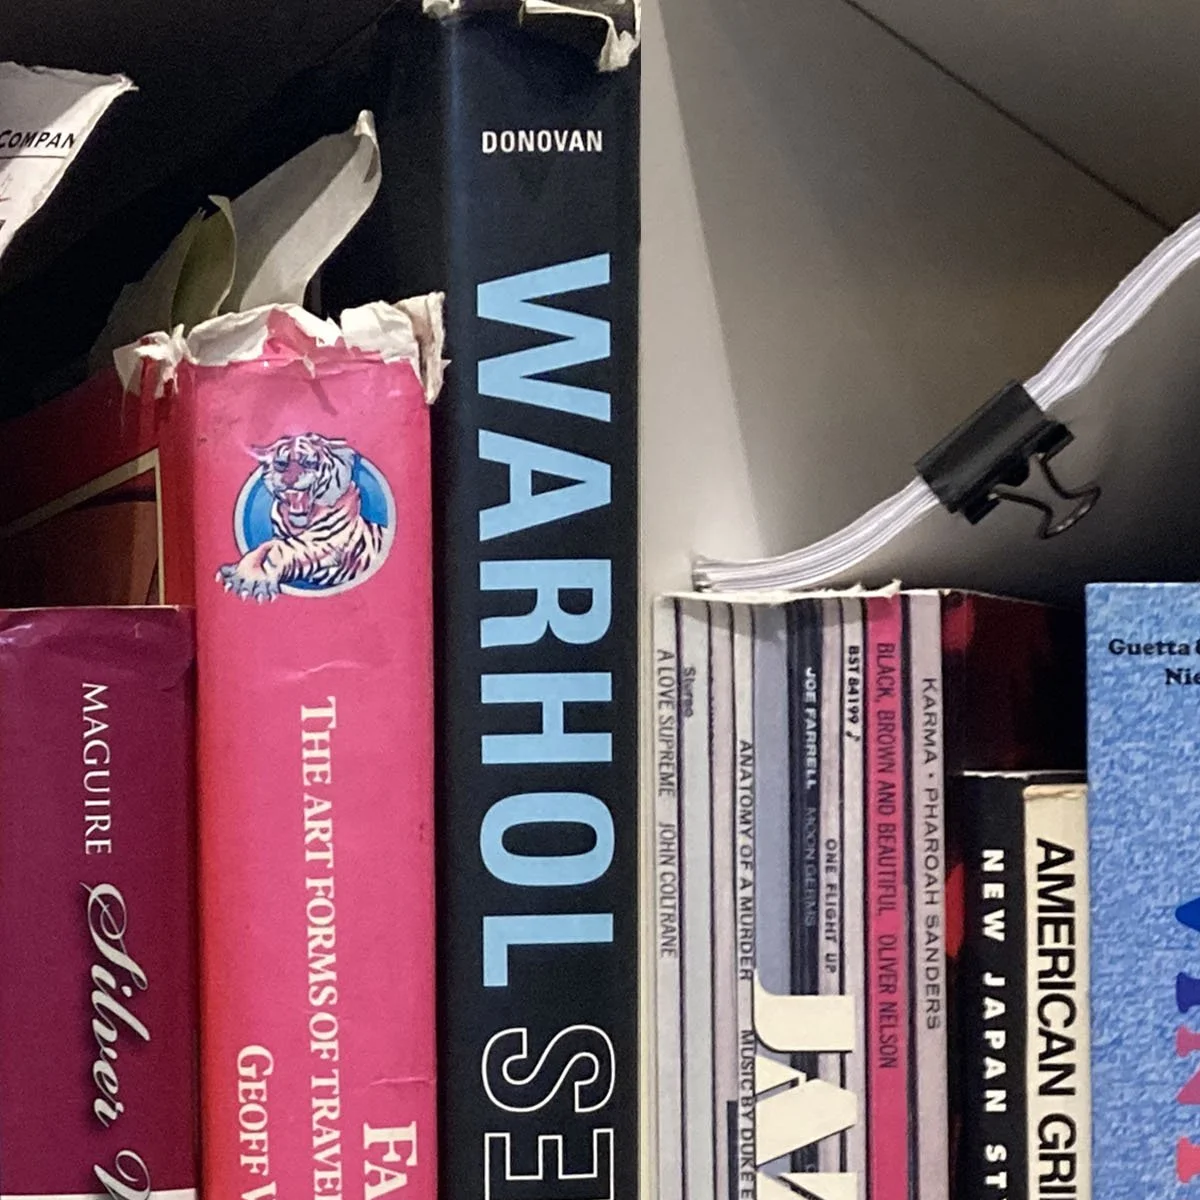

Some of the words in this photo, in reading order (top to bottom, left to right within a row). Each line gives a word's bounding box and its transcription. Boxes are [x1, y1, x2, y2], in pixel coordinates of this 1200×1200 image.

[481, 129, 603, 154] DONOVAN
[476, 253, 615, 987] WARHOL
[1108, 638, 1190, 656] Guetta
[657, 649, 675, 661] A
[658, 667, 675, 708] LOVE
[805, 667, 819, 702] JOE
[875, 643, 897, 703] BLACK,
[300, 695, 337, 786] THE
[805, 708, 820, 789] FARRELL
[877, 709, 898, 773] BROWN
[923, 677, 938, 763] KARMA
[82, 682, 112, 855] MAGUIRE
[658, 714, 676, 797] SUPREME
[739, 740, 754, 838] ANATOMY
[303, 793, 334, 869] ART
[878, 780, 898, 816] AND
[658, 821, 677, 866] JOHN
[740, 845, 754, 870] OF
[825, 839, 837, 874] ONE
[878, 823, 899, 916] BEAUTIFUL
[925, 787, 940, 905] PHAROAH
[659, 871, 678, 958] COLTRANE
[740, 877, 754, 891] A
[825, 883, 838, 943] FLIGHT
[982, 849, 1005, 942] NEW
[305, 876, 338, 1007] FORMS
[740, 898, 754, 981] MURDER
[826, 953, 838, 973] UP
[879, 934, 899, 994] OLIVER
[927, 914, 941, 1030] SANDERS
[1036, 837, 1077, 1096] AMERICAN
[80, 881, 152, 1129] Silver
[309, 1011, 339, 1062] OF
[879, 1001, 899, 1068] NELSON
[741, 1030, 757, 1090] MUSIC
[983, 972, 1007, 1112] JAPAN
[237, 1044, 274, 1177] GEOFF
[740, 1097, 755, 1121] BY
[740, 1128, 756, 1180] DUKE
